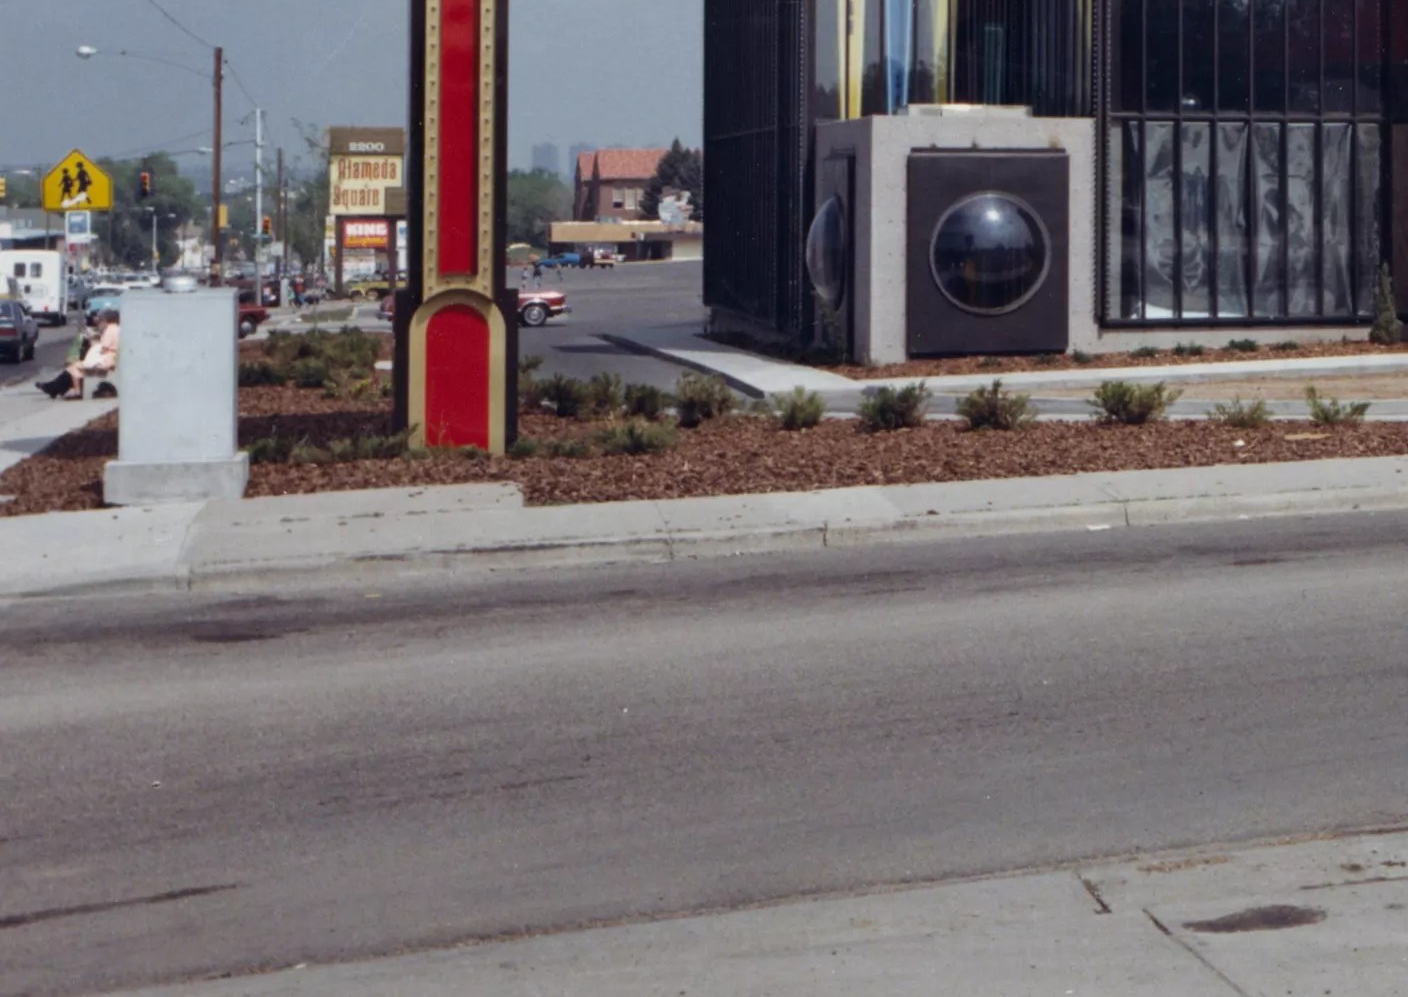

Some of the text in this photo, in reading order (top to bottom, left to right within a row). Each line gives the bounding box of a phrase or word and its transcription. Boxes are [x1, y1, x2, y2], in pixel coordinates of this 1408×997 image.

[338, 158, 396, 180] Alameda
[333, 185, 380, 210] Square
[345, 223, 387, 235] KING
